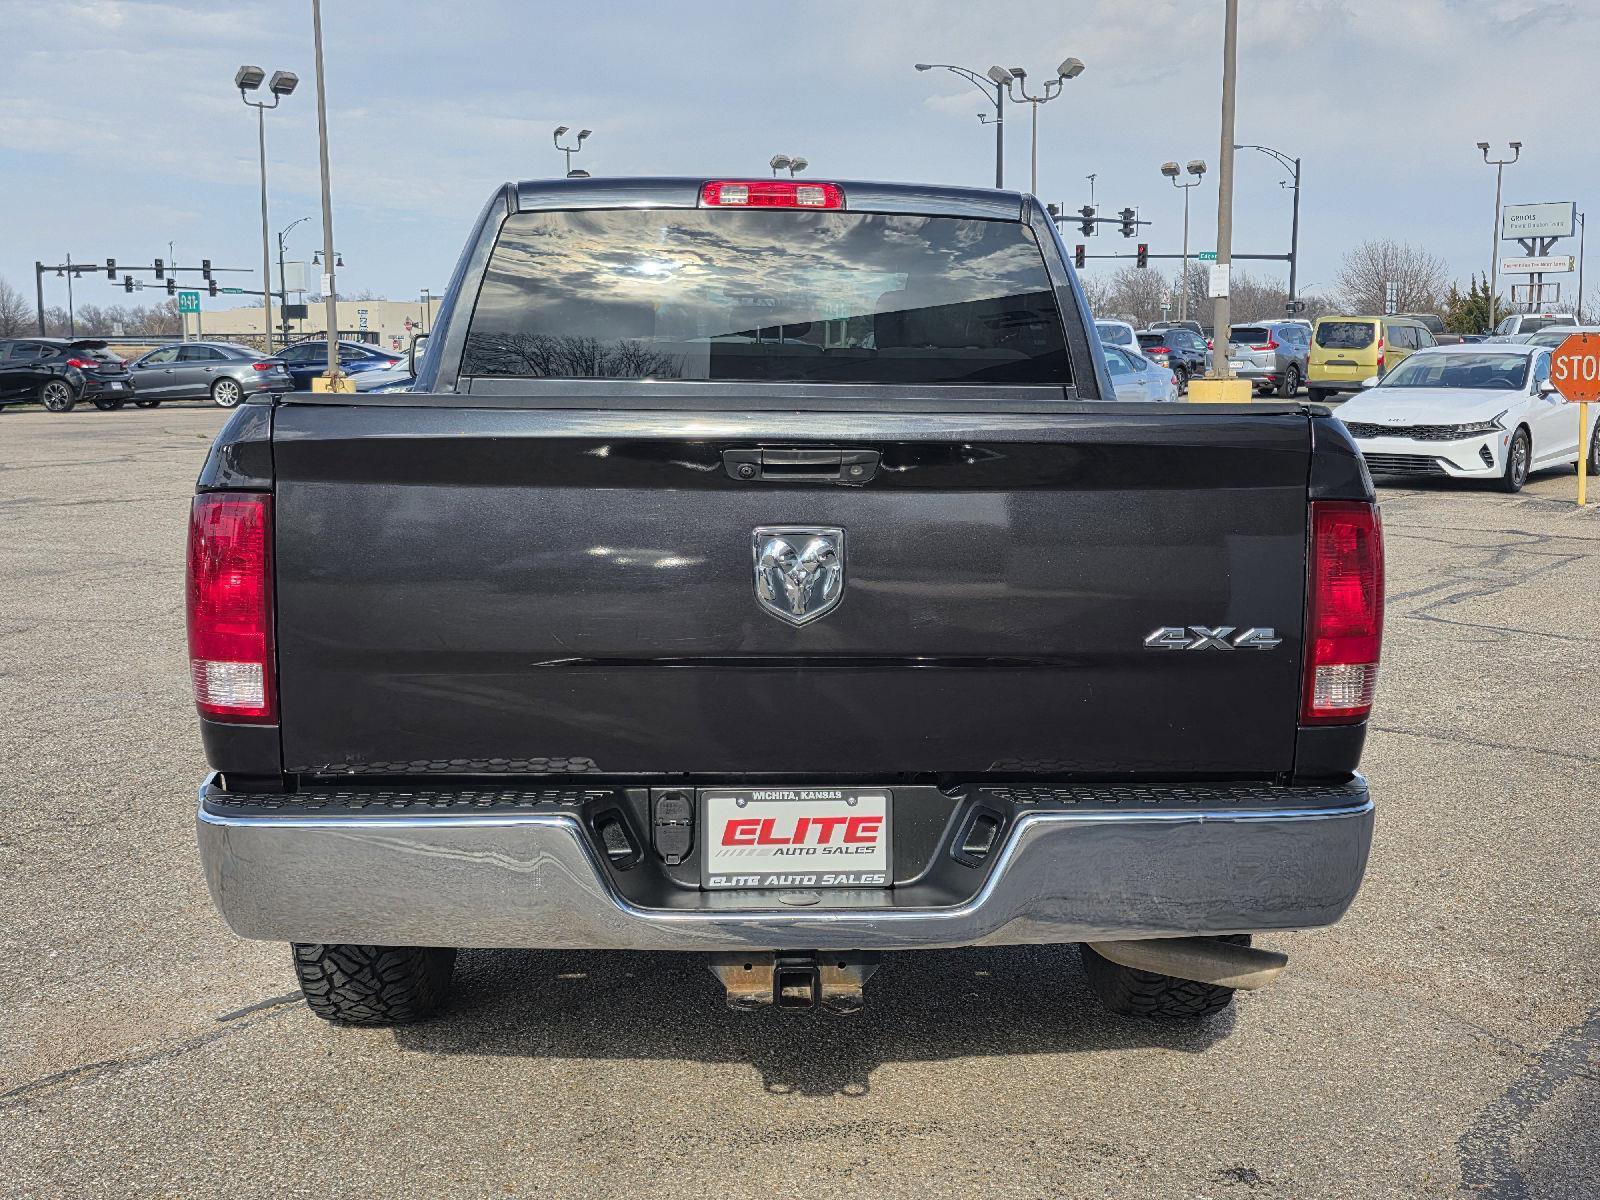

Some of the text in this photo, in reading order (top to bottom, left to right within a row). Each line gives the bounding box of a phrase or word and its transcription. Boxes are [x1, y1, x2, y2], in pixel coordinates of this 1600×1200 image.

[1556, 355, 1600, 381] STO
[1143, 626, 1283, 651] 4X4
[752, 791, 842, 800] WICHITA, KANSAS
[721, 816, 884, 847] ELITE
[773, 846, 877, 856] AUTO SALES
[709, 874, 886, 887] ELITE AUTO SALES
